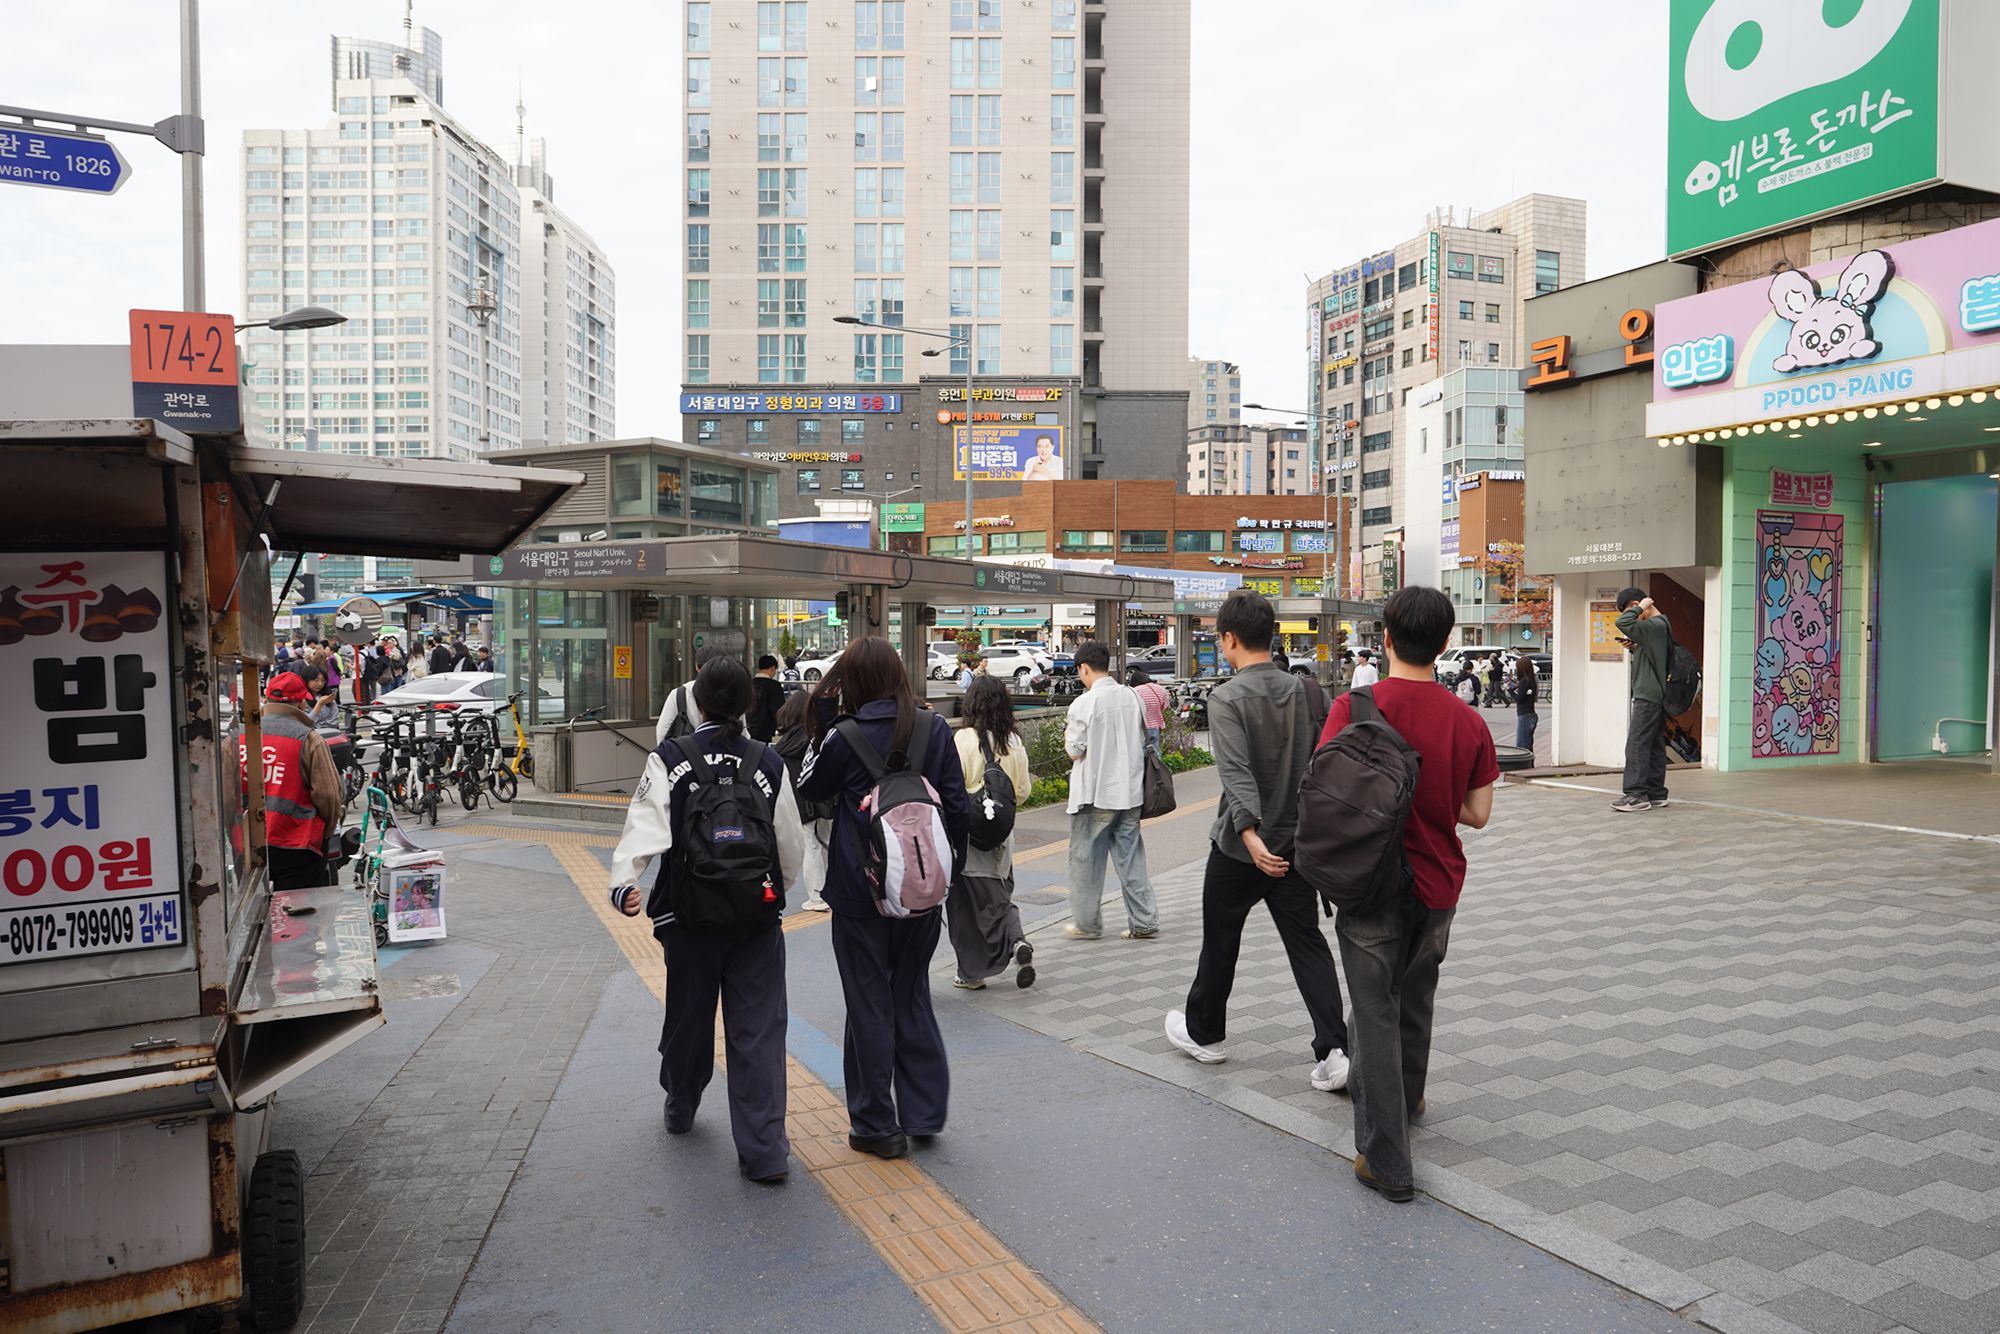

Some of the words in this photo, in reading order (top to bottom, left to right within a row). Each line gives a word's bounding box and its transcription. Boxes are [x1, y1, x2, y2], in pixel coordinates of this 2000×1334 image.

[65, 154, 111, 177] 1826
[143, 323, 224, 373] 174-2
[1527, 335, 1576, 386] 코
[1662, 335, 1734, 387] 인형
[1046, 388, 1062, 402] 2F
[1762, 368, 1914, 411] PPOCO-PANG
[163, 392, 210, 408] 관악로
[687, 396, 761, 411] 서울대입구
[765, 396, 823, 411] 정형외과
[828, 396, 856, 411] 의원
[860, 397, 885, 411] 5층
[163, 410, 212, 419] Gwanak-ro
[972, 451, 1017, 467] 박준희
[574, 550, 592, 558] Seoul
[593, 550, 609, 558] Nat'l
[609, 549, 626, 557] Univ.
[638, 550, 646, 562] 2
[1585, 542, 1622, 553] 서울대본점
[520, 551, 569, 568] 서울대입구
[993, 570, 1021, 584] 서울대입구
[21, 560, 98, 633] 주
[33, 654, 156, 764] 밤
[239, 744, 277, 765] BG
[3, 837, 153, 896] 00원
